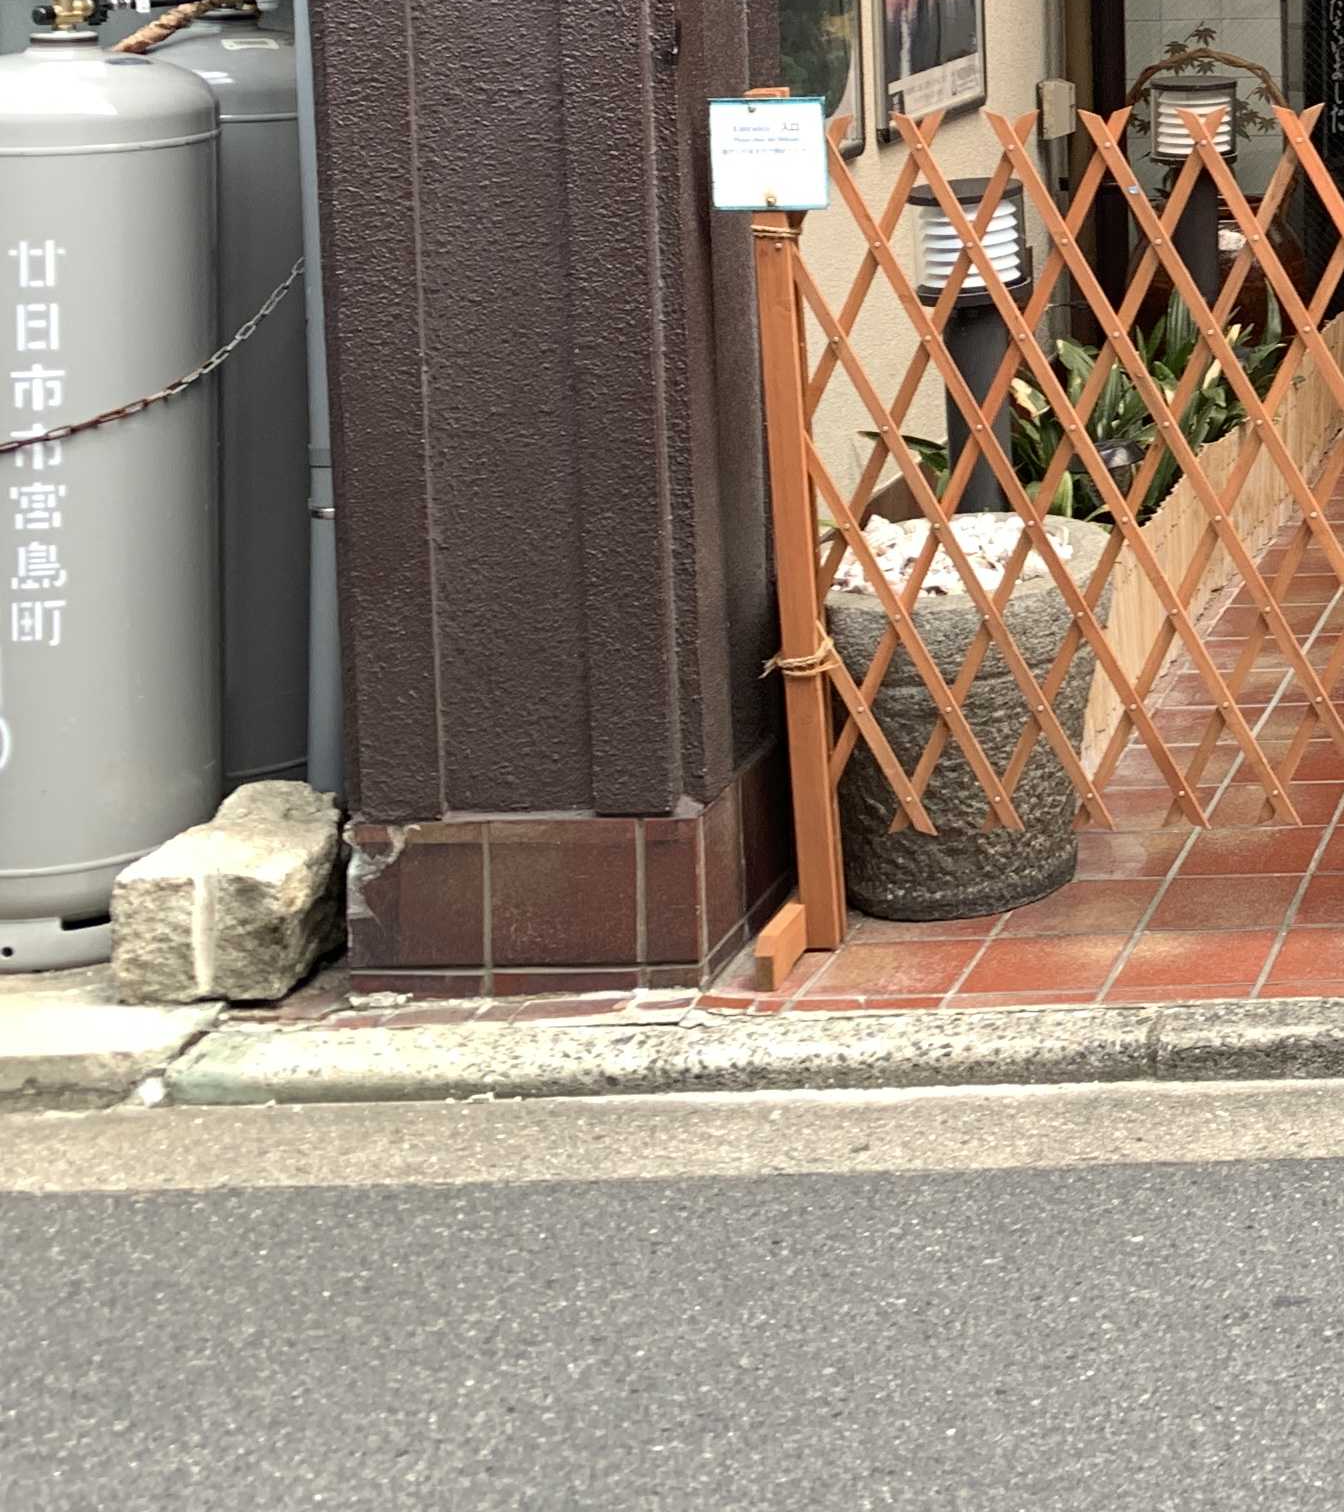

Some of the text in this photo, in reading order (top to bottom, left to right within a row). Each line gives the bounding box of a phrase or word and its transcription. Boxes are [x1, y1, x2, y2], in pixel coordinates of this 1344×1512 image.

[7, 238, 68, 648] 廿日市市宮島町
